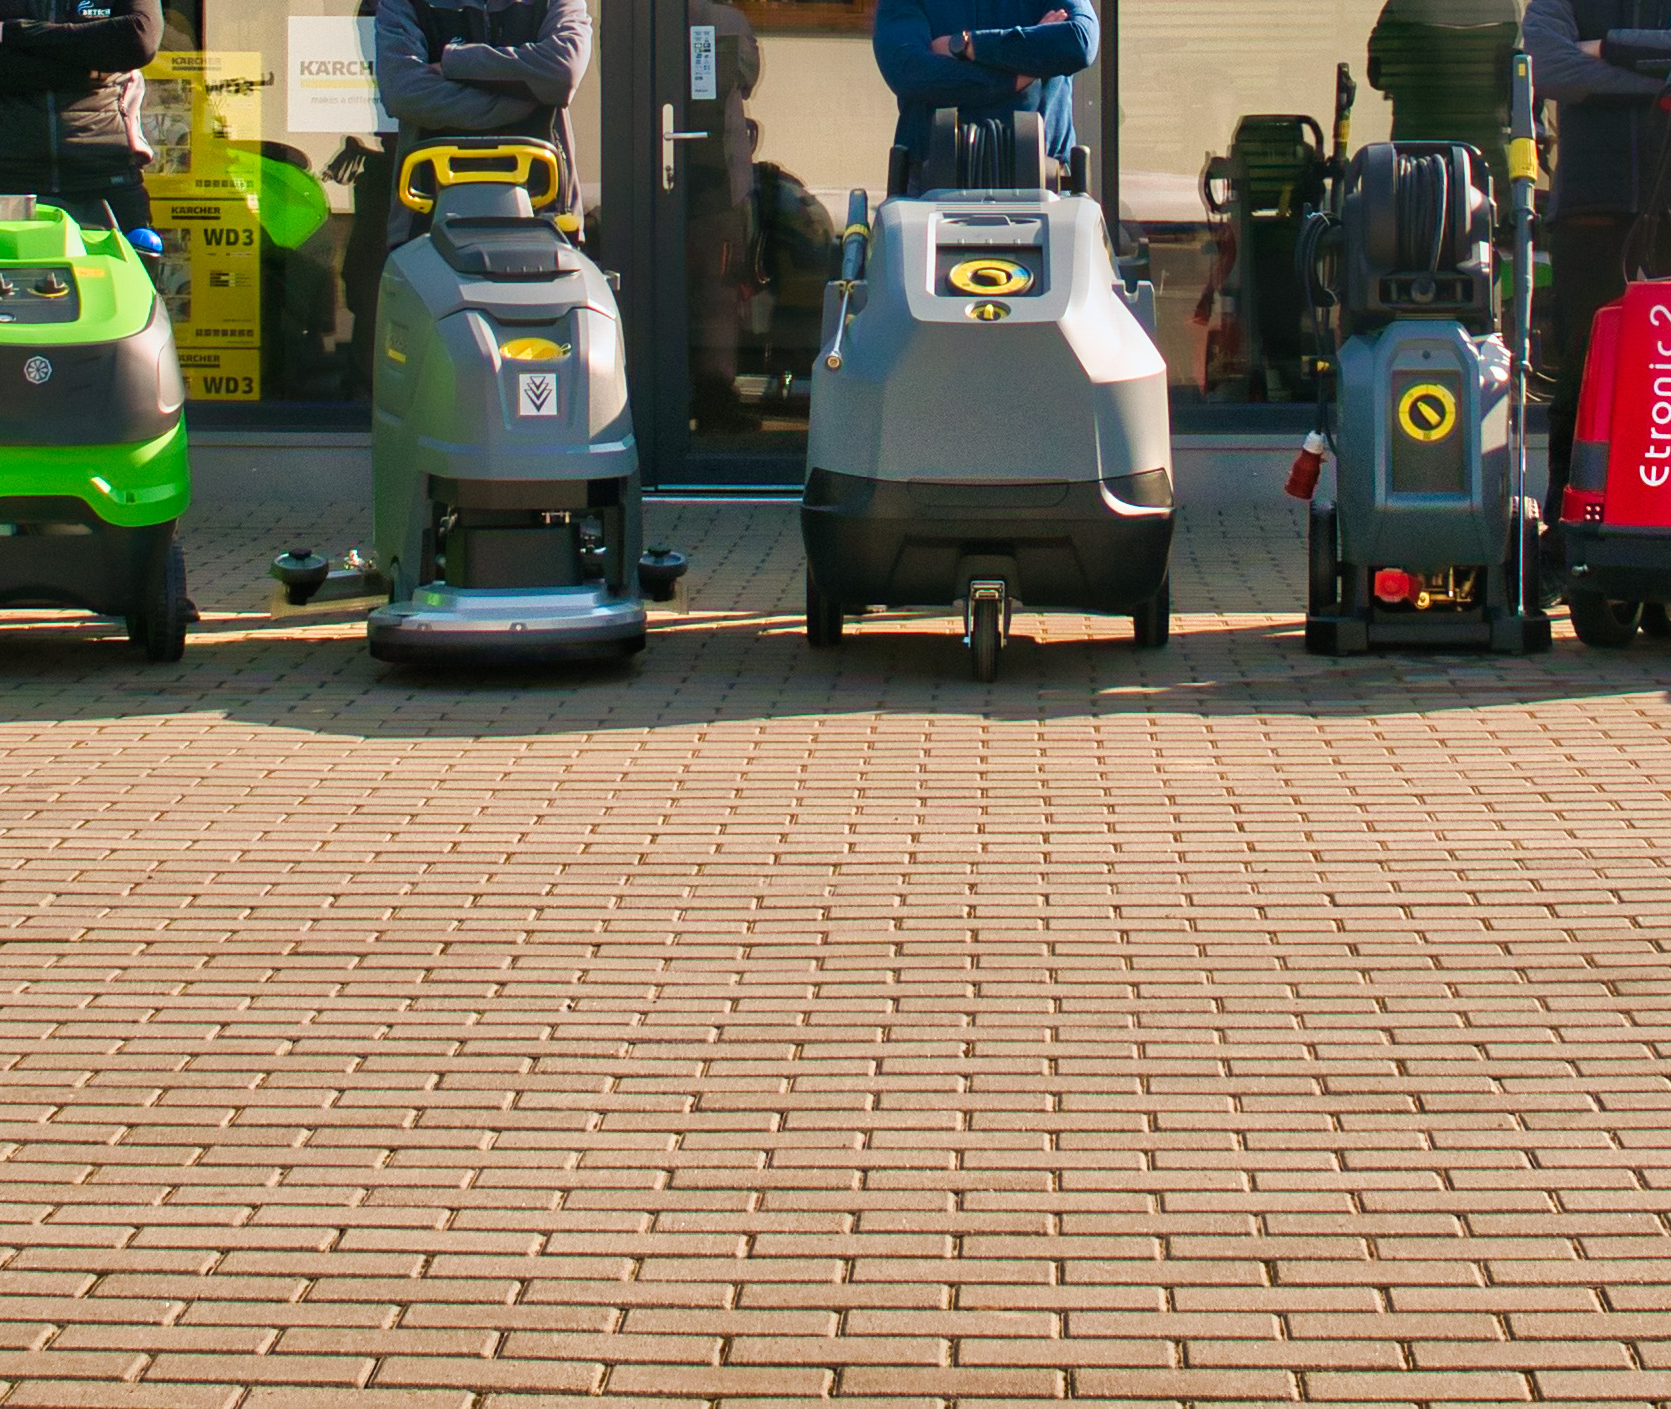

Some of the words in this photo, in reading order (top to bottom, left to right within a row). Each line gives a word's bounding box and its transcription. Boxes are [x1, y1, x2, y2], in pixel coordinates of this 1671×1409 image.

[300, 60, 374, 76] KÄRCH
[203, 228, 240, 246] WD
[242, 229, 254, 246] 3
[203, 376, 239, 394] WD
[242, 376, 254, 394] 3
